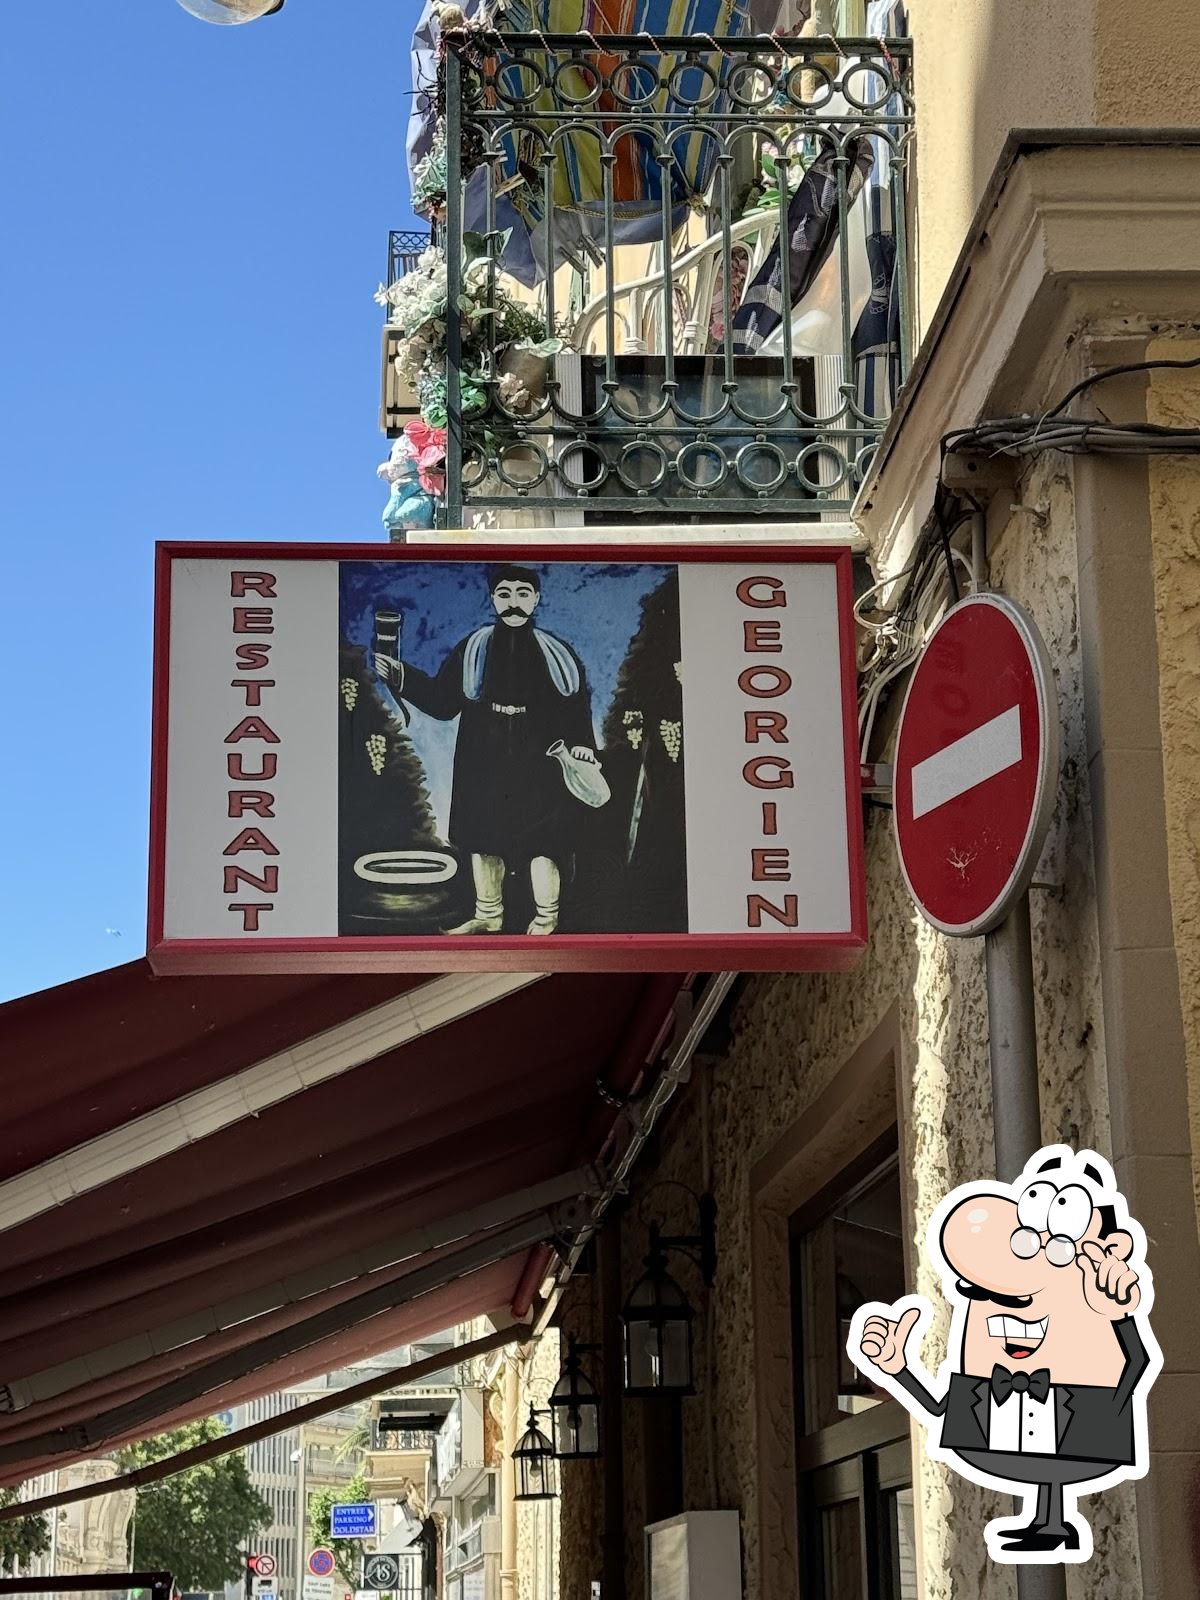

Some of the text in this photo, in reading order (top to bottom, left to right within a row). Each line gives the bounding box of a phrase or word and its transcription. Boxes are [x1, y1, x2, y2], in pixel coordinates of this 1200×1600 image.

[223, 571, 281, 931] RESTAURANT
[736, 576, 798, 928] GEORGIEN
[334, 1516, 368, 1524] PARKING
